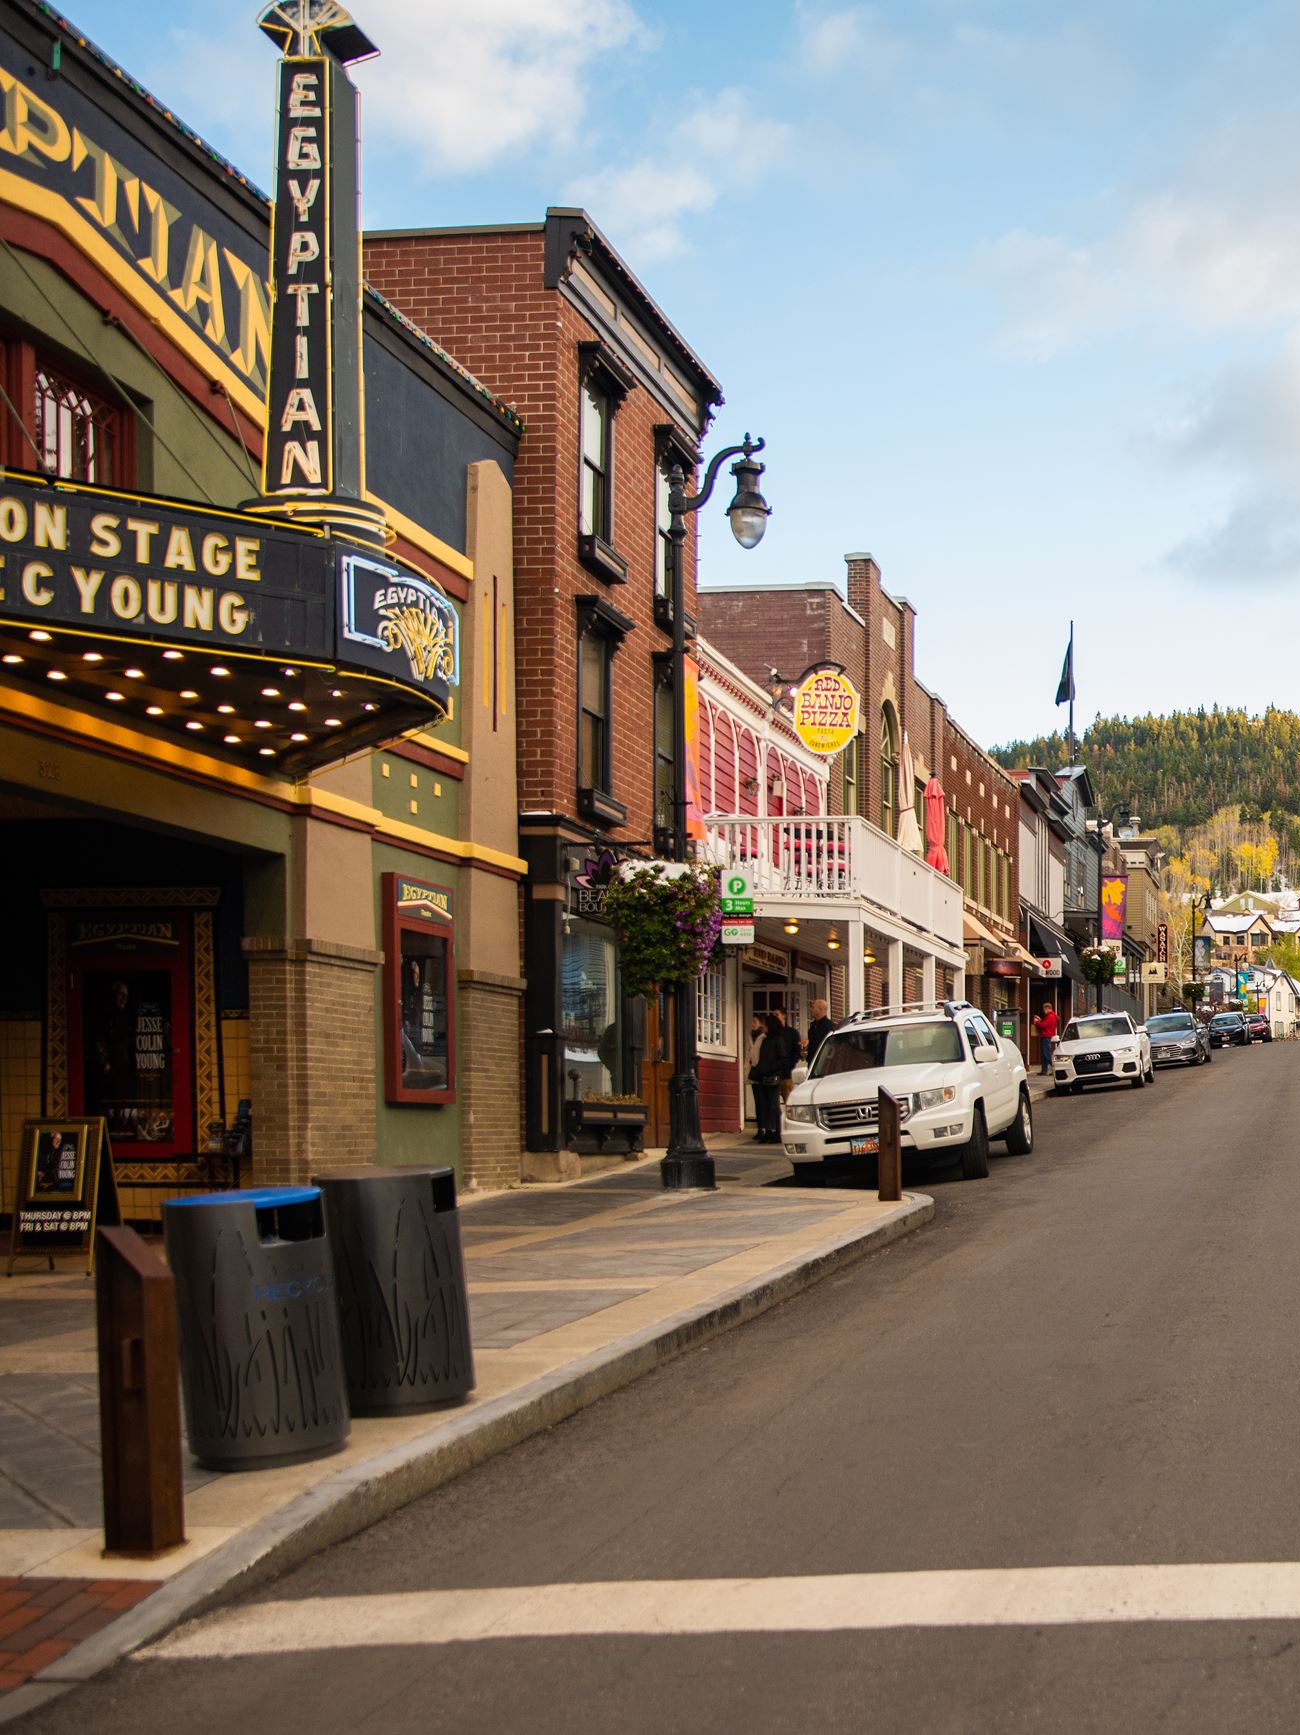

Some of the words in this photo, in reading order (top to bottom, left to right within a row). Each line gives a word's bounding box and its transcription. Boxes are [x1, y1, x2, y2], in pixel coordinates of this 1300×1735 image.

[280, 73, 322, 485] EGYPTIAN
[0, 496, 67, 550] ON
[90, 512, 261, 582] STAGE
[70, 565, 249, 635] YOUNG
[814, 677, 841, 692] RED
[801, 693, 853, 711] BANJO
[800, 710, 852, 728] PIZZA
[402, 883, 448, 911] EGYPTIAN
[725, 900, 733, 911] 3
[79, 923, 172, 939] EGYPTIAN
[1158, 926, 1167, 962] WASATCH
[136, 1017, 162, 1032] JESSE
[136, 1034, 163, 1050] COLIN
[135, 1053, 165, 1069] YOUNG
[61, 1151, 76, 1160] JESSE
[60, 1161, 75, 1169] COLIN
[58, 1170, 75, 1179] YOUNG
[20, 1211, 63, 1220] THURSDAY
[63, 1211, 71, 1220] @
[72, 1211, 91, 1220] 8PM
[20, 1222, 33, 1232] FRI
[35, 1222, 42, 1231] &
[43, 1222, 59, 1231] SAT
[60, 1221, 69, 1231] @
[69, 1221, 88, 1231] 8PM
